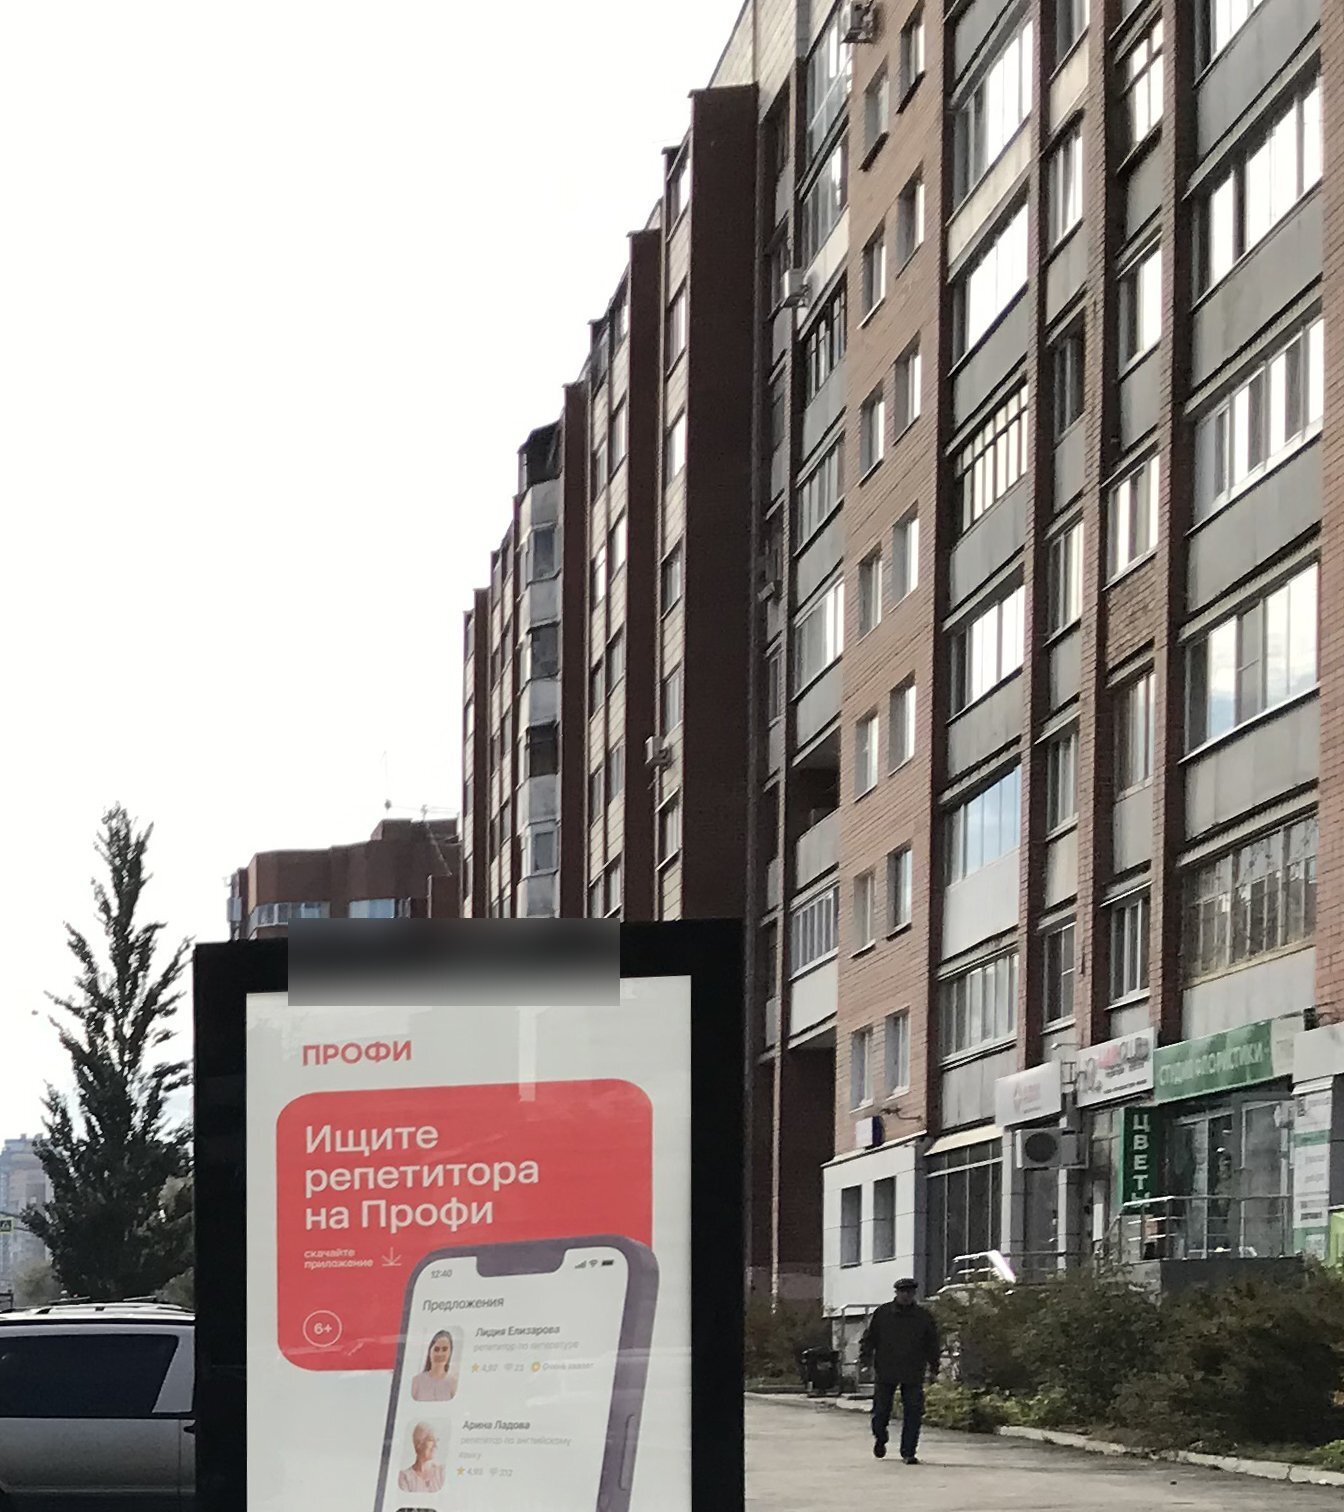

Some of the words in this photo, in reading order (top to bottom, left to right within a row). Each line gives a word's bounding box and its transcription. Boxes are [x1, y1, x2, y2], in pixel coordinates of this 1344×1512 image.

[302, 1040, 412, 1066] ПРОФИ
[305, 1124, 440, 1157] Ищите
[305, 1159, 540, 1199] репетитора
[305, 1205, 350, 1230] на
[361, 1197, 494, 1234] Профи
[304, 1248, 355, 1259] скачайте
[304, 1257, 374, 1270] приложение
[422, 1296, 505, 1313] Предложения
[313, 1322, 333, 1336] 6+
[475, 1326, 506, 1338] Лидия
[507, 1325, 561, 1337] Елизарова
[462, 1420, 493, 1431] Арина
[493, 1420, 531, 1431] Ладова
